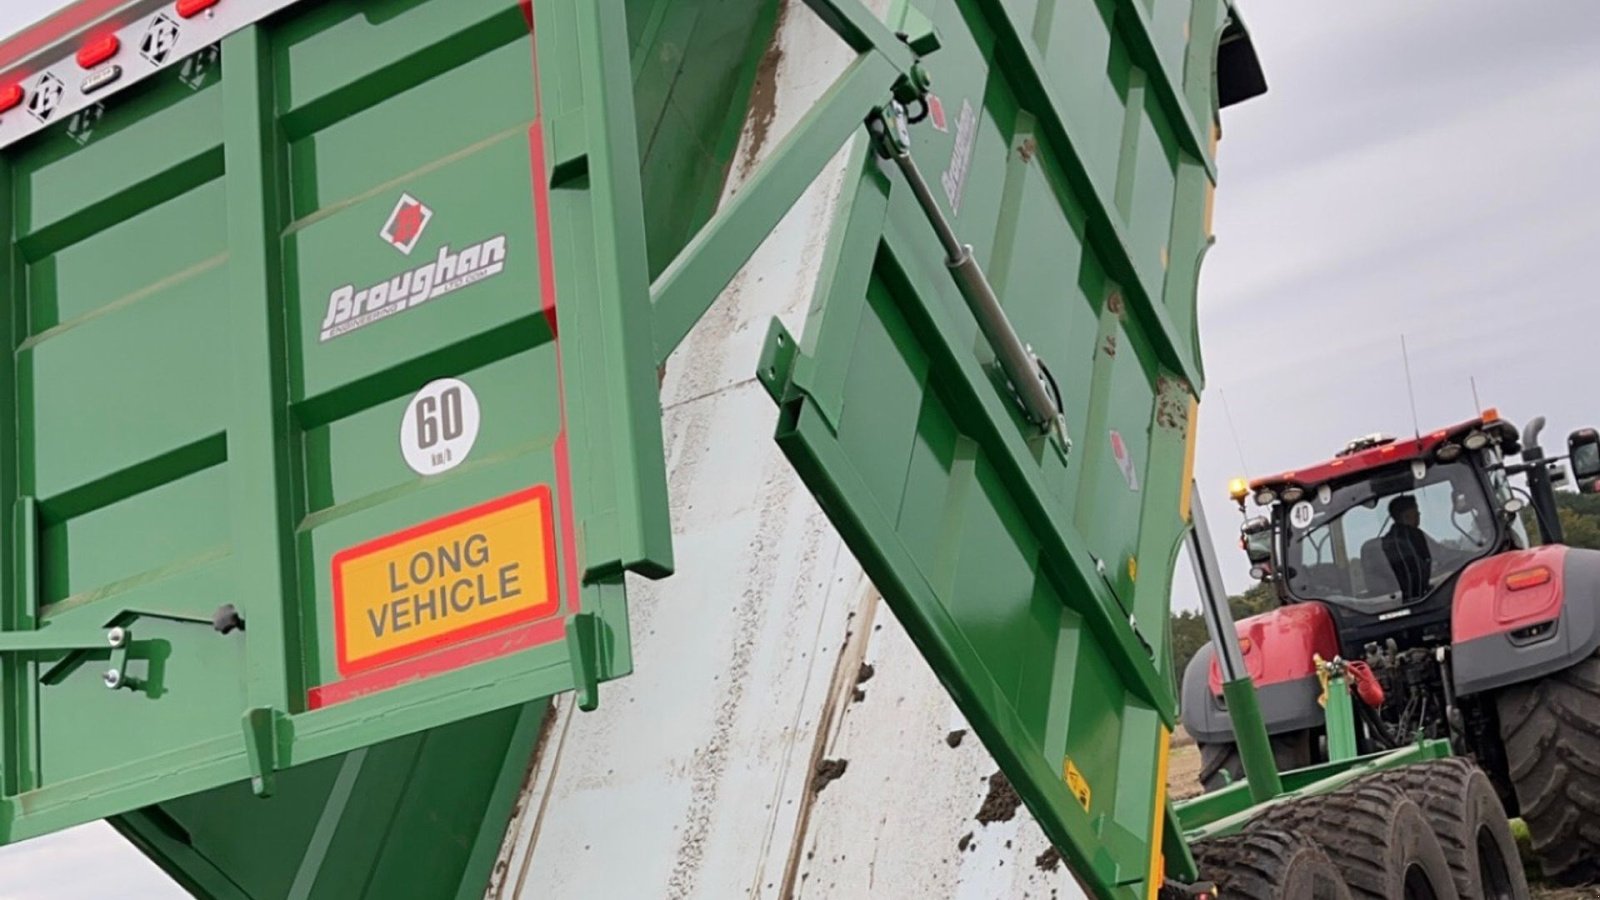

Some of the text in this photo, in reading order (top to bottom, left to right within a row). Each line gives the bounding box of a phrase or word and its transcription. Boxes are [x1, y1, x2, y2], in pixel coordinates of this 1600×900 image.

[321, 235, 506, 330] Broughan
[329, 302, 398, 338] ENGINEERING
[415, 386, 463, 450] 60
[431, 448, 452, 467] km/h
[387, 533, 490, 593] LONG
[367, 563, 521, 638] VEHICLE
